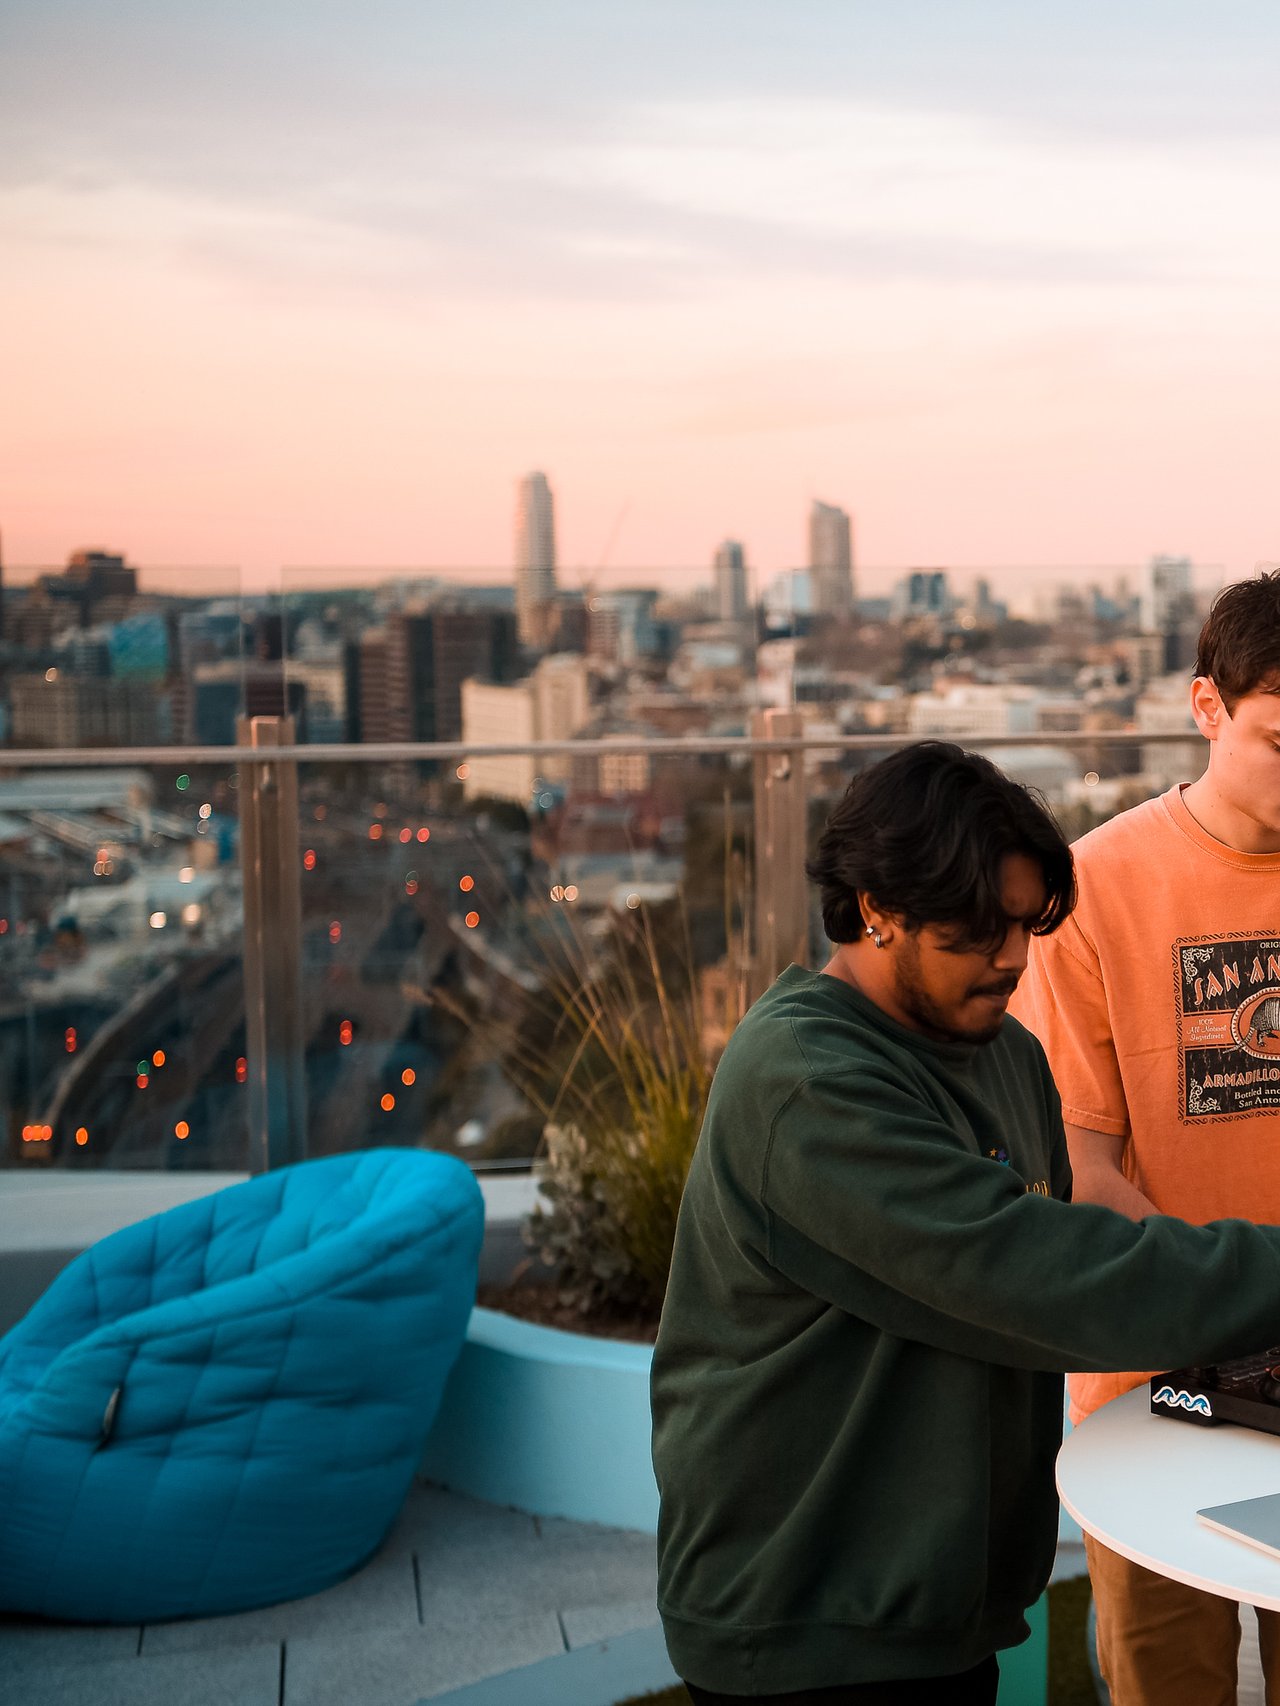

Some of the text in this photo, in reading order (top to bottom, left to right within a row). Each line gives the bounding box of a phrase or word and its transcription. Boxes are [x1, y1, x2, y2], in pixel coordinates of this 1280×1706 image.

[1194, 961, 1241, 1006] SAN
[1203, 1067, 1280, 1089] ARMADILLO
[1234, 1087, 1262, 1100] Bottled
[1238, 1100, 1253, 1108] San
